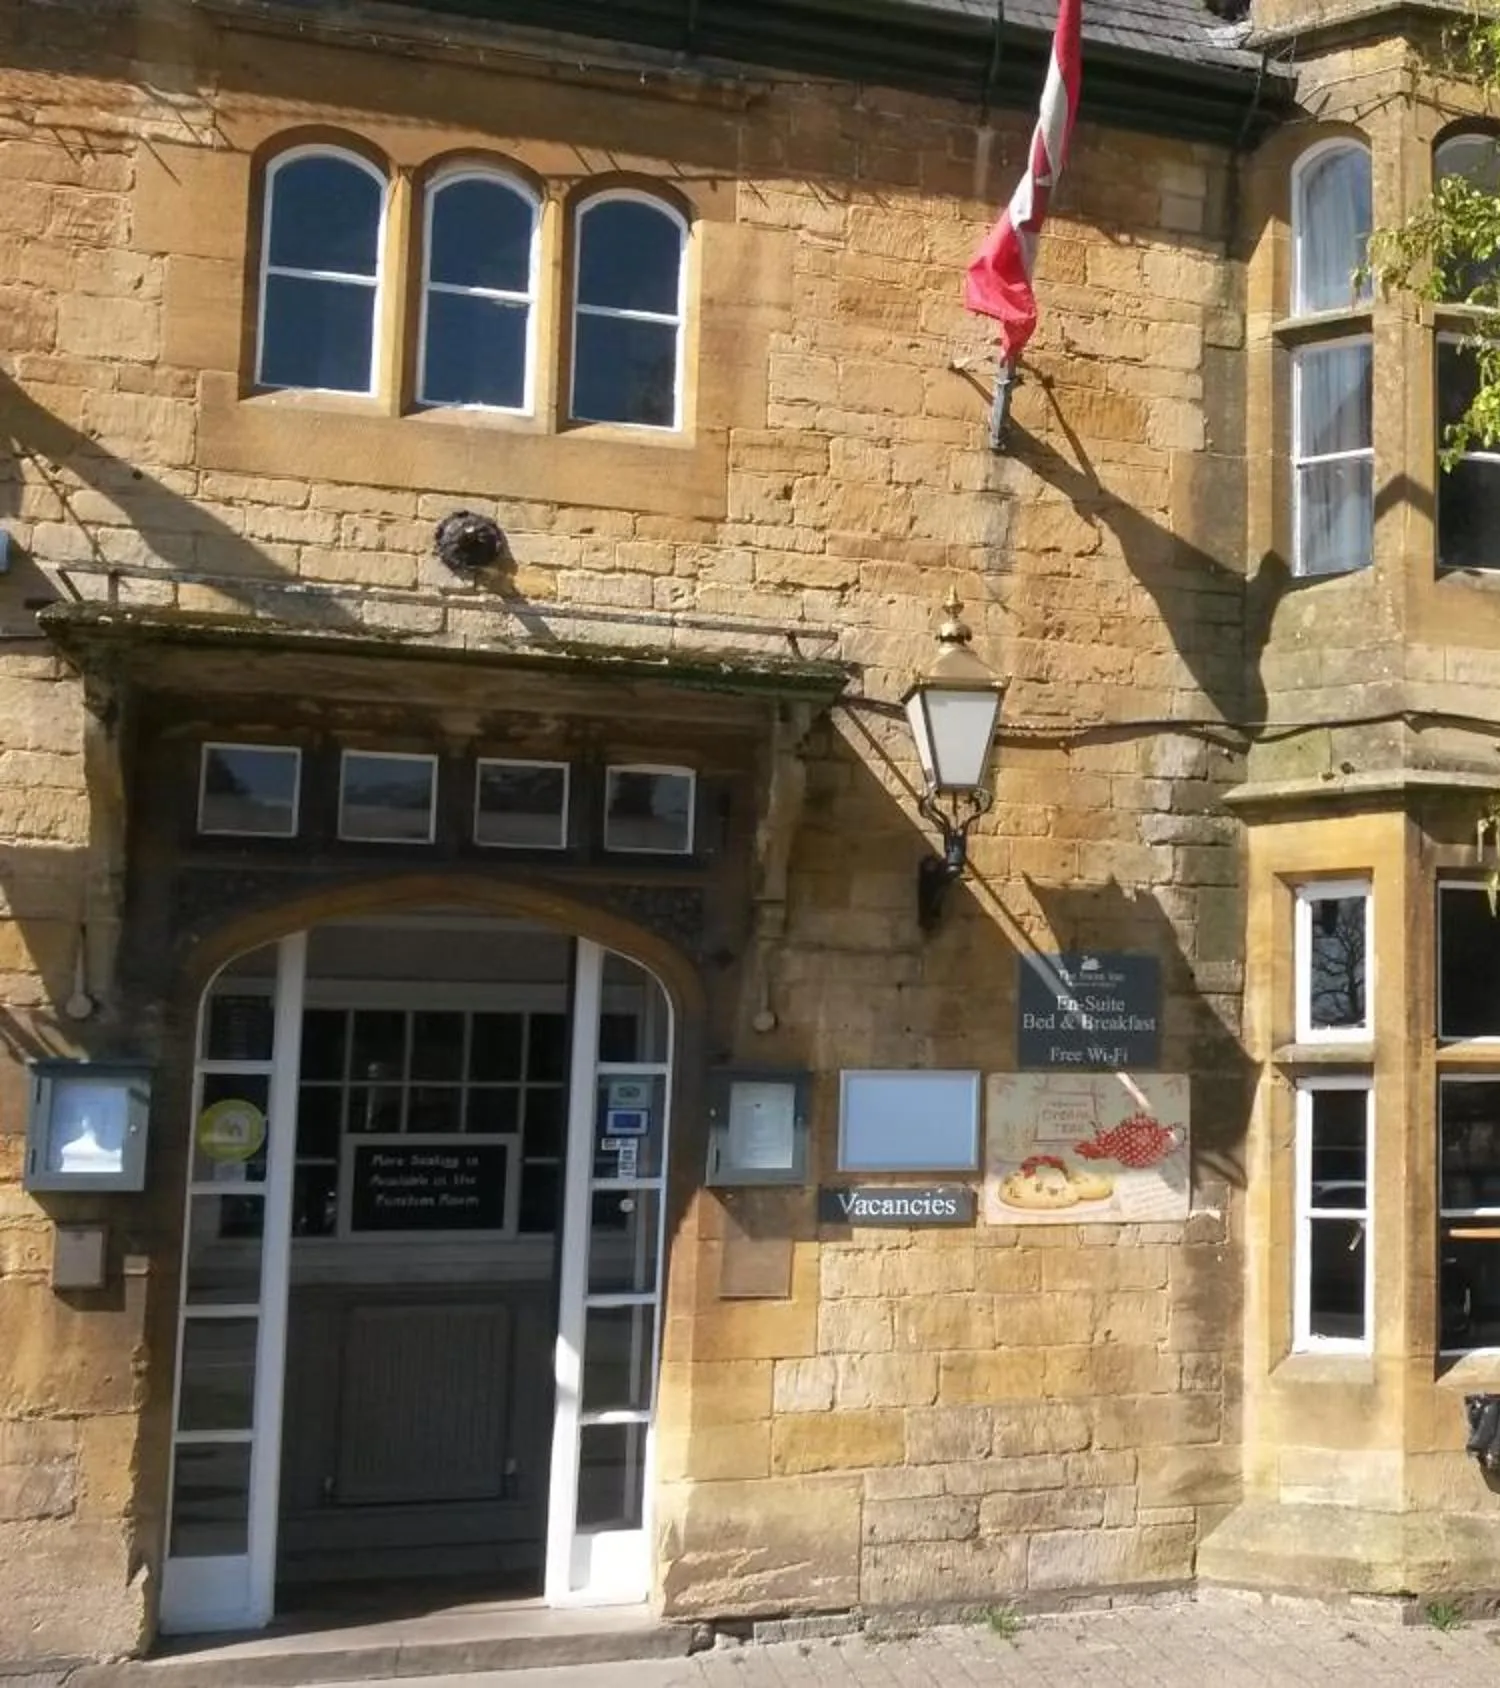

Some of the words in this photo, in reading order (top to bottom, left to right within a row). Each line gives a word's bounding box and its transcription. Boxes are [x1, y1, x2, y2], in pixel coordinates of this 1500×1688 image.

[1056, 995, 1125, 1012] En-Suite
[1023, 1013, 1055, 1029] Bed
[1060, 1015, 1077, 1030] &
[1081, 1013, 1156, 1031] Breakfast
[1050, 1047, 1082, 1062] Free
[837, 1191, 957, 1215] Vacancies
